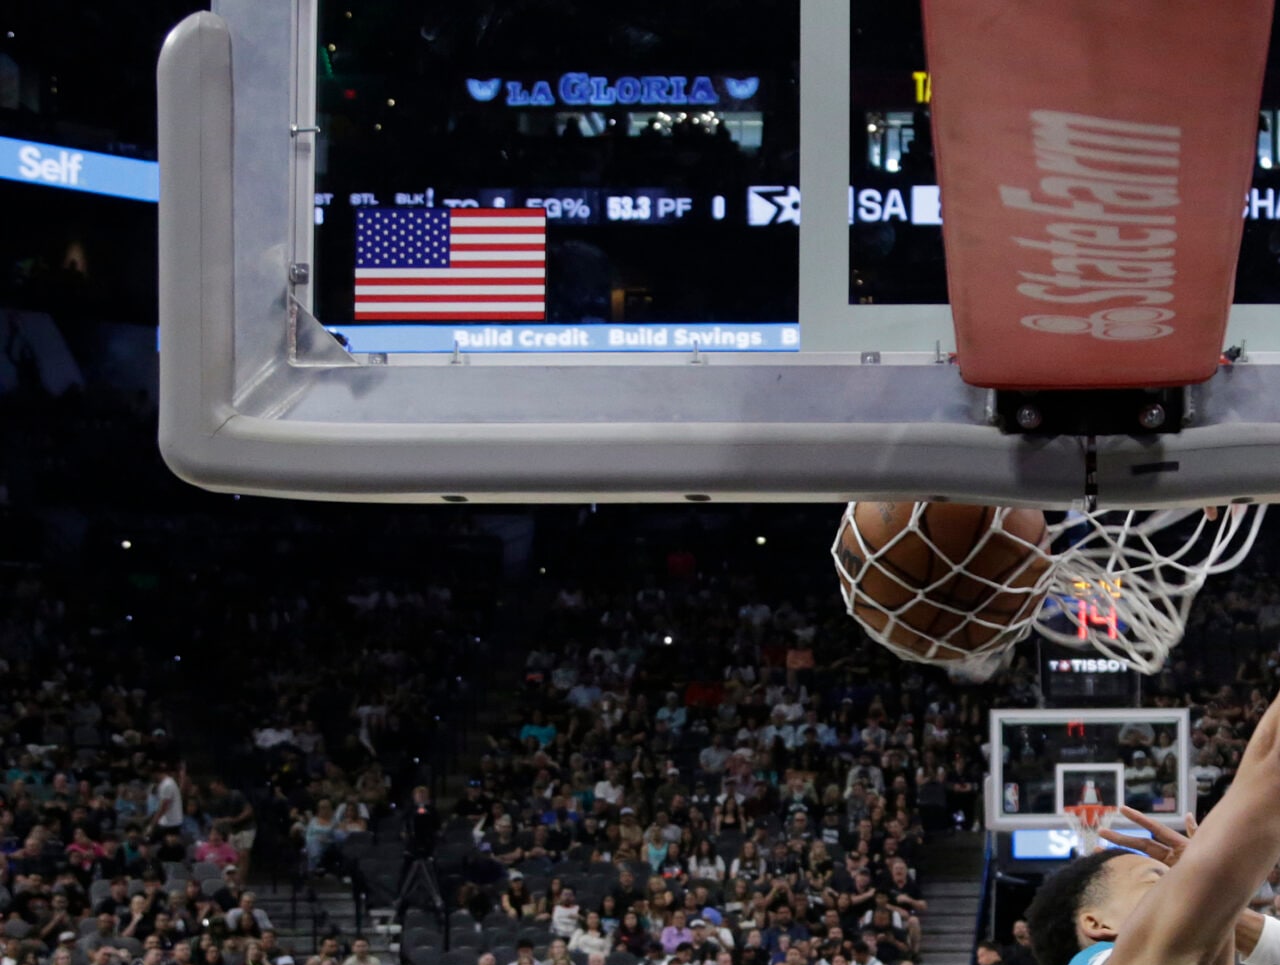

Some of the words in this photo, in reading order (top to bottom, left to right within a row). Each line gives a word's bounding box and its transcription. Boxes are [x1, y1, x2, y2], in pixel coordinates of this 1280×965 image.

[18, 145, 84, 185] Self
[658, 198, 692, 218] PF
[454, 328, 513, 347] Build
[518, 328, 590, 346] Credit
[608, 328, 668, 347] Build
[673, 328, 762, 350] Savings
[1070, 659, 1129, 673] TISSOT
